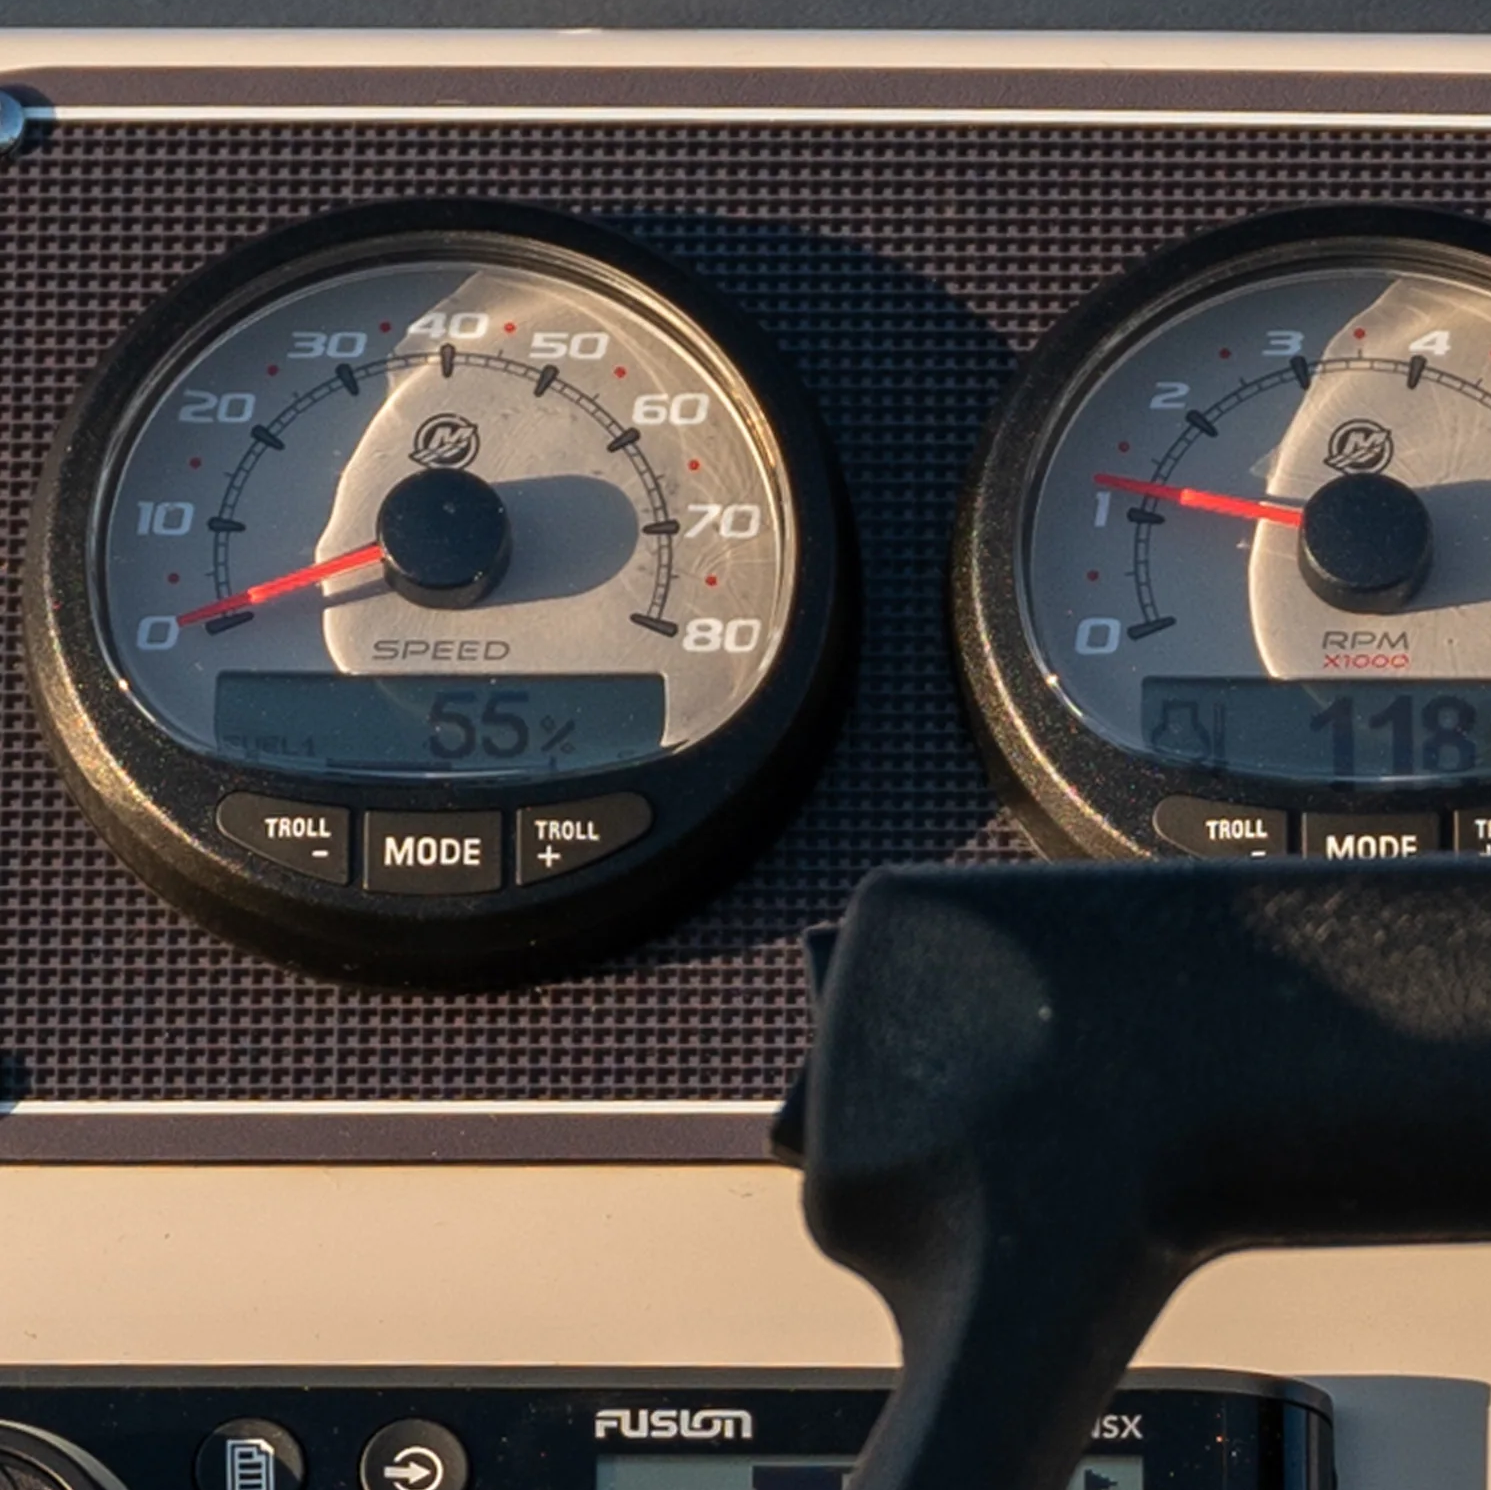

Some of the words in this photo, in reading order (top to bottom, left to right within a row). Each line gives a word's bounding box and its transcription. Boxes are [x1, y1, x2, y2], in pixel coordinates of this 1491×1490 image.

[406, 312, 489, 340] 40
[287, 331, 369, 360] 30
[529, 332, 609, 360] 50
[1262, 330, 1305, 356] 3
[1409, 330, 1452, 356] 4
[177, 393, 255, 423] 20
[631, 394, 709, 424] 60
[1149, 382, 1190, 408] 2
[136, 503, 194, 536] 10
[683, 504, 762, 537] 70
[1094, 492, 1110, 527] 1
[135, 617, 181, 651] 0
[681, 618, 762, 652] 80
[1075, 618, 1121, 656] 0
[1321, 631, 1410, 650] RPM
[372, 639, 510, 661] SPEED
[1323, 654, 1410, 669] X1000
[265, 818, 331, 838] TROLL
[535, 821, 599, 840] TROLL
[1206, 819, 1267, 839] TROLL
[384, 837, 481, 866] MODE
[1326, 836, 1417, 859] MODE
[595, 1409, 753, 1440] FUSION
